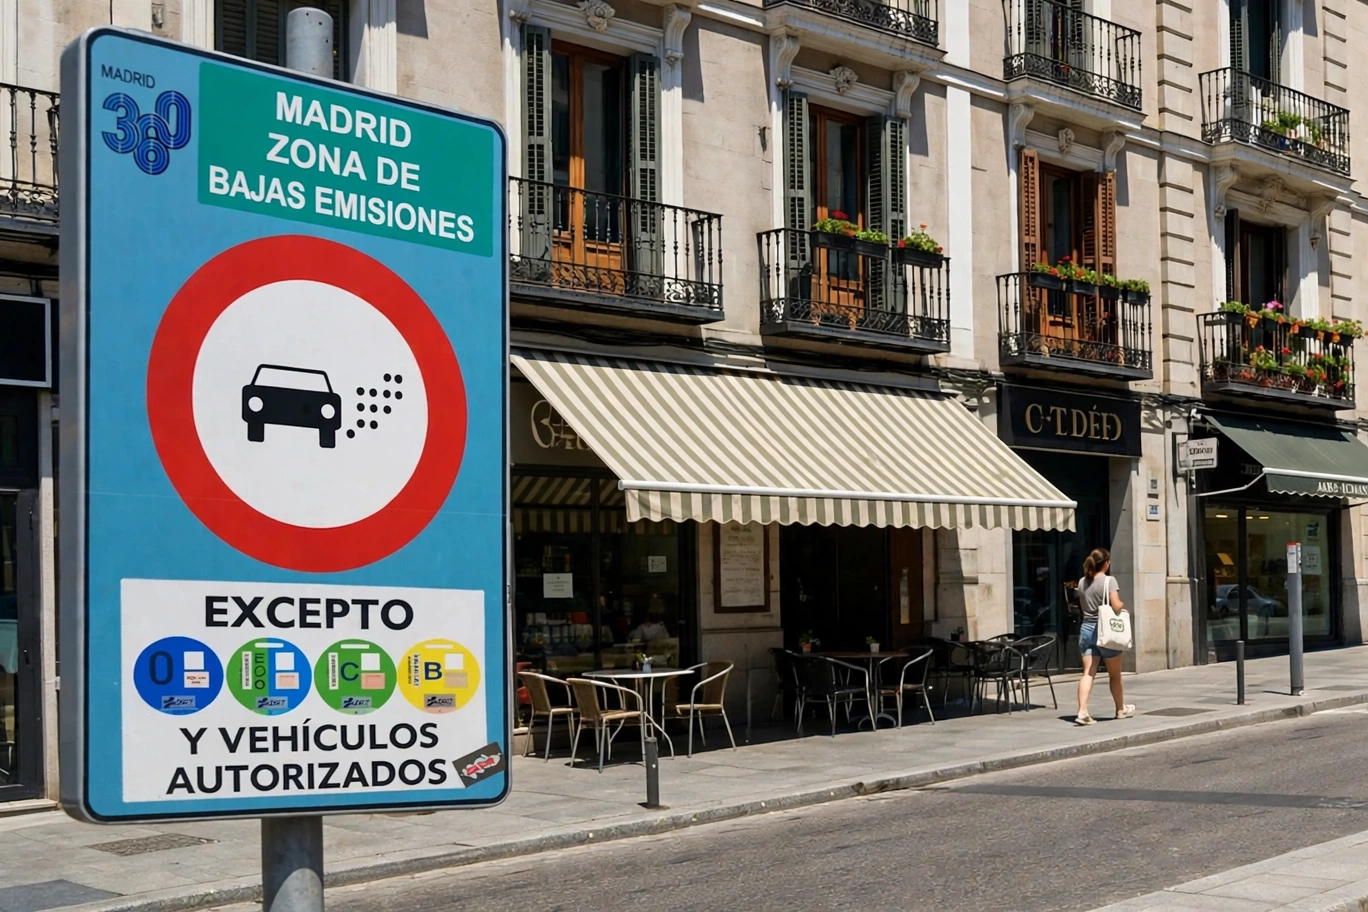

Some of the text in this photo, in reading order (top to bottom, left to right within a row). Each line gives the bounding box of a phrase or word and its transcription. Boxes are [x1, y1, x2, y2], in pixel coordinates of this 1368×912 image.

[101, 64, 155, 89] MADRID
[102, 90, 192, 175] 360
[276, 91, 412, 148] MADRID
[266, 132, 420, 191] ZONA DE
[209, 165, 474, 243] BAJAS EMISIONES
[205, 595, 414, 630] EXCEPTO
[340, 662, 359, 682] C
[424, 662, 443, 681] B
[180, 718, 439, 755] Y VEHÍCULOS
[166, 758, 447, 795] AUTORIZADOS
